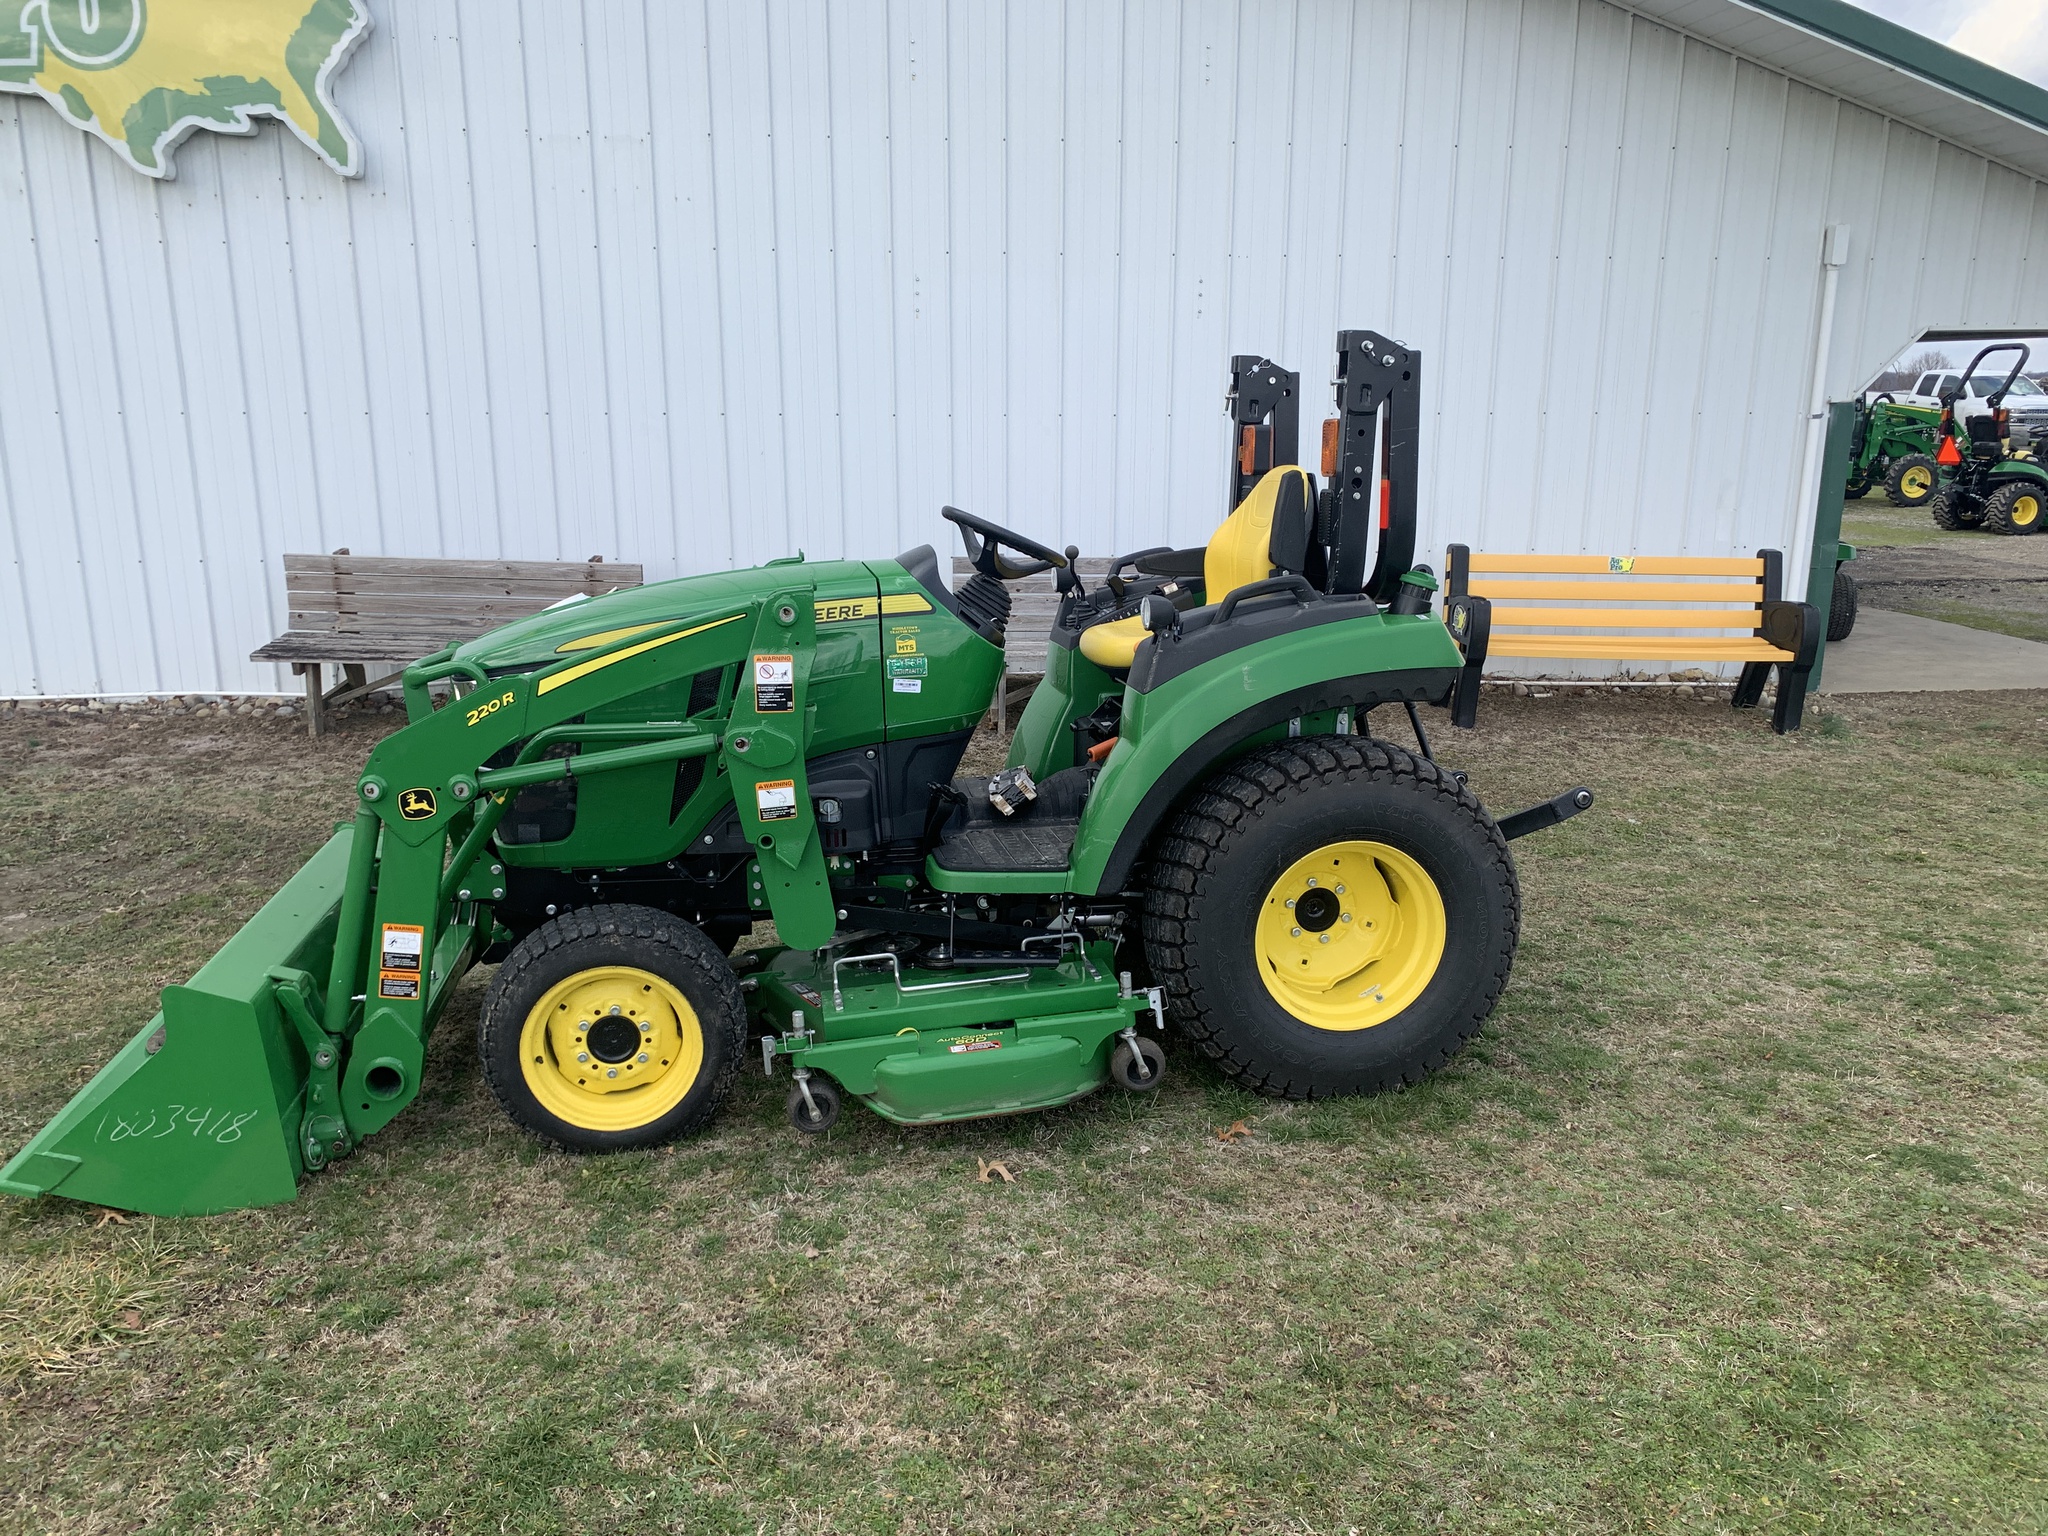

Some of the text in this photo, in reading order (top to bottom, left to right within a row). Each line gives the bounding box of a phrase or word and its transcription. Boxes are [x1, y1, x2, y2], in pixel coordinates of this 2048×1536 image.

[898, 644, 915, 652] MTS
[466, 691, 515, 727] 220 R
[763, 780, 793, 789] WARNING
[1216, 950, 1304, 1064] GALAXY
